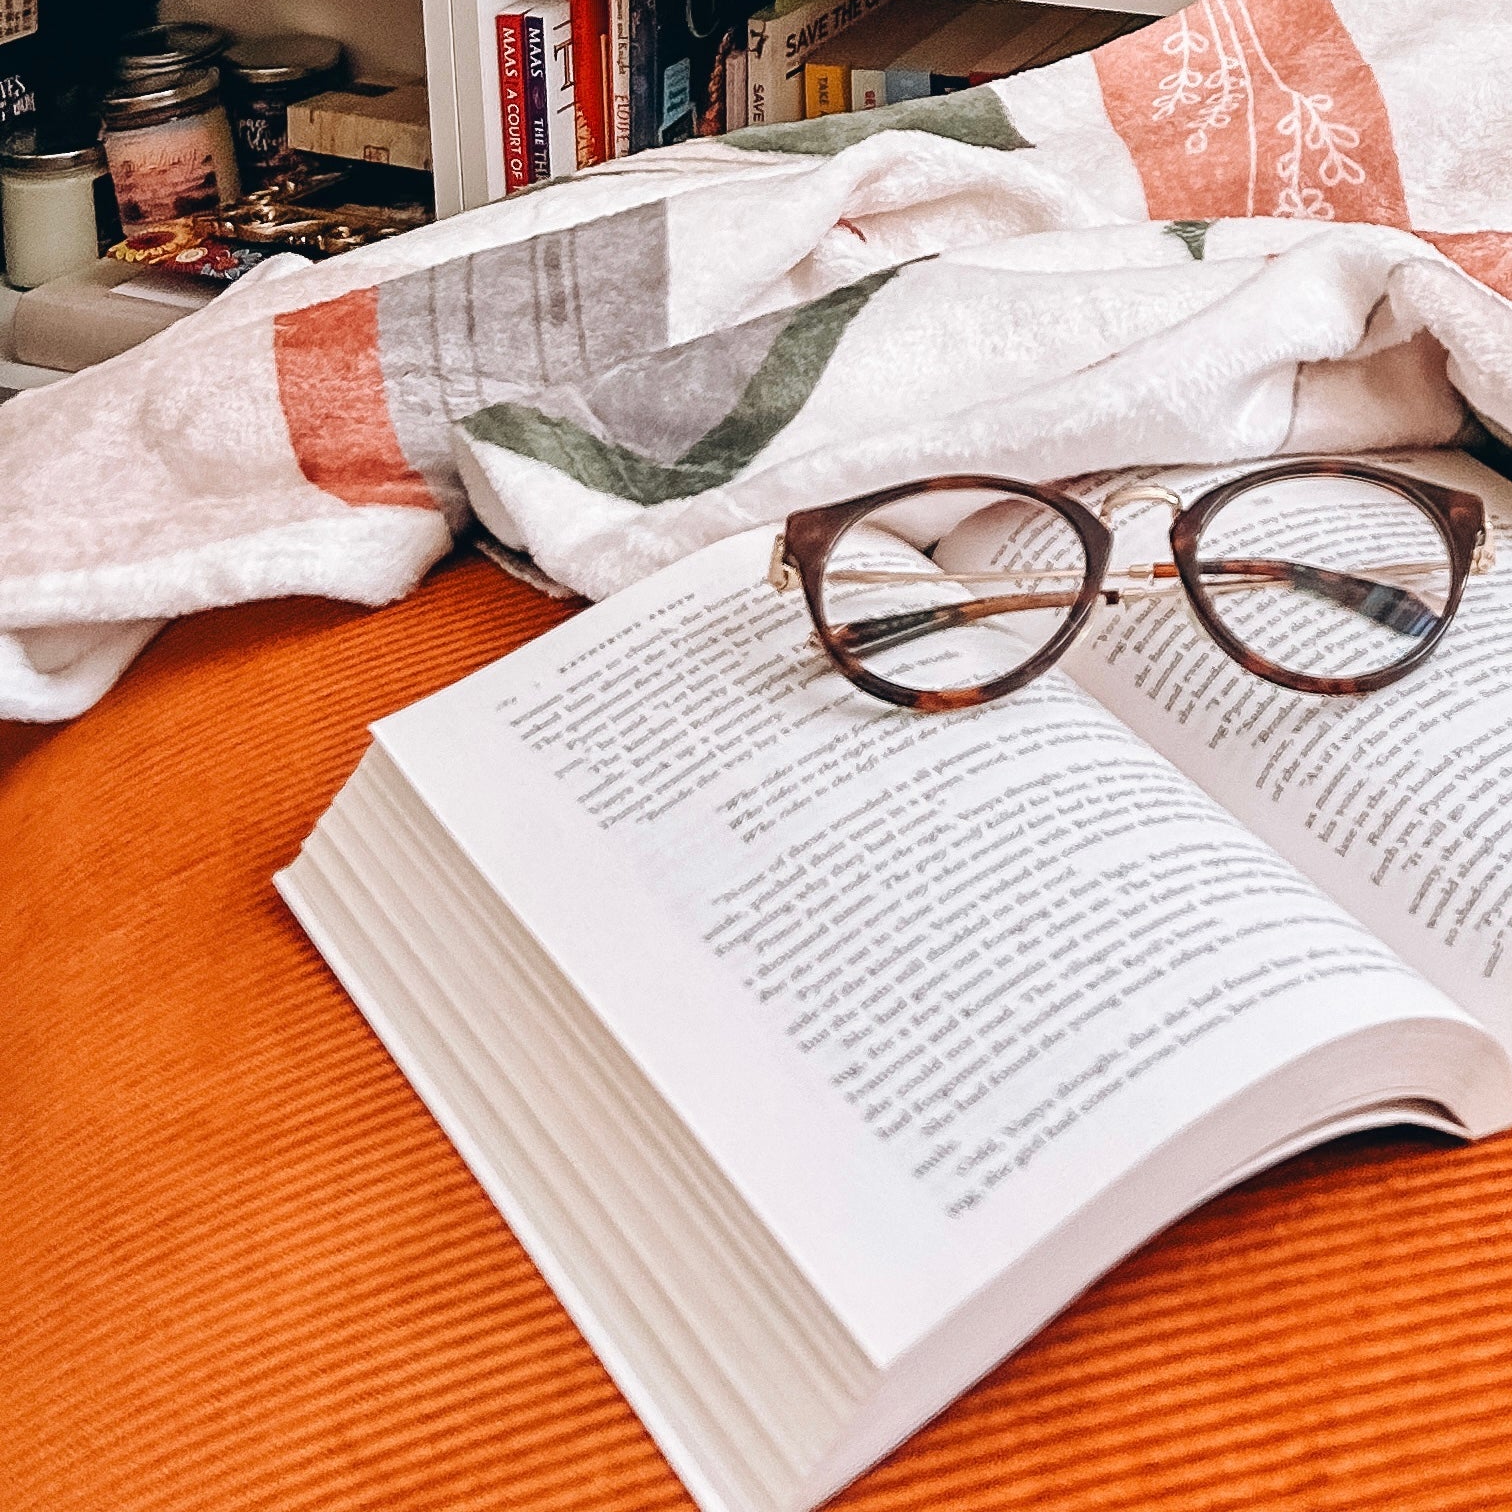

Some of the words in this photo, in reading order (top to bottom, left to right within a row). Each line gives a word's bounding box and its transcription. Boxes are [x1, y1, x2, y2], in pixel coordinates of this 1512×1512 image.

[502, 27, 518, 78] MAAS
[528, 27, 544, 78] MAAS
[785, 14, 829, 58] SAVE
[505, 88, 518, 100] A
[752, 83, 765, 123] SAVE
[506, 103, 522, 155] COURT
[532, 118, 545, 146] THE
[510, 160, 523, 180] OF
